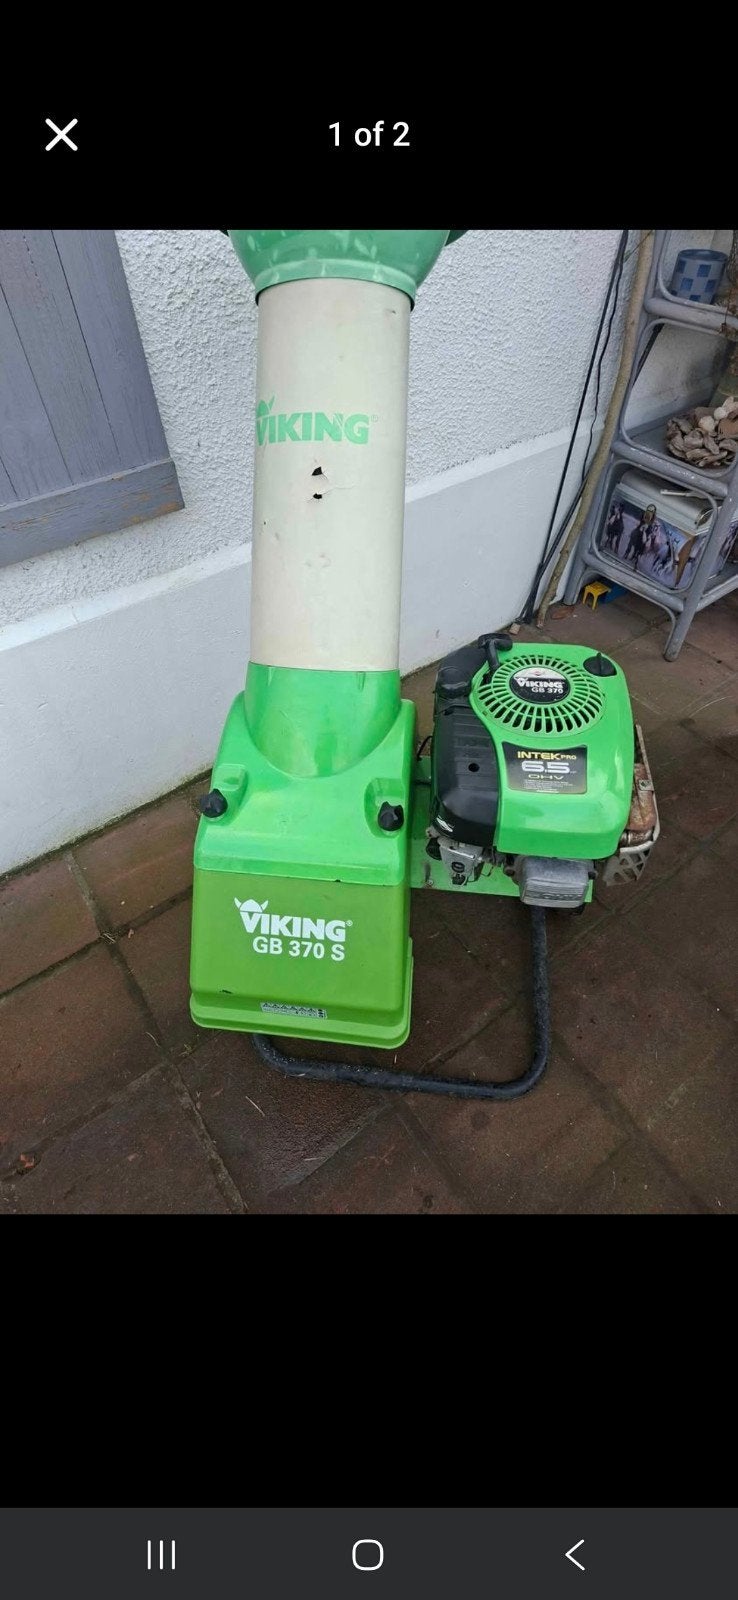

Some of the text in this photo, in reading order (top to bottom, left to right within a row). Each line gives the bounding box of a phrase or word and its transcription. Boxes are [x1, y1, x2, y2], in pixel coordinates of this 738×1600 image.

[516, 678, 563, 688] VIKING
[517, 751, 561, 760] INTEK
[521, 760, 571, 774] 6.5
[240, 911, 346, 942] VIKING
[252, 936, 346, 962] GB 370 S
